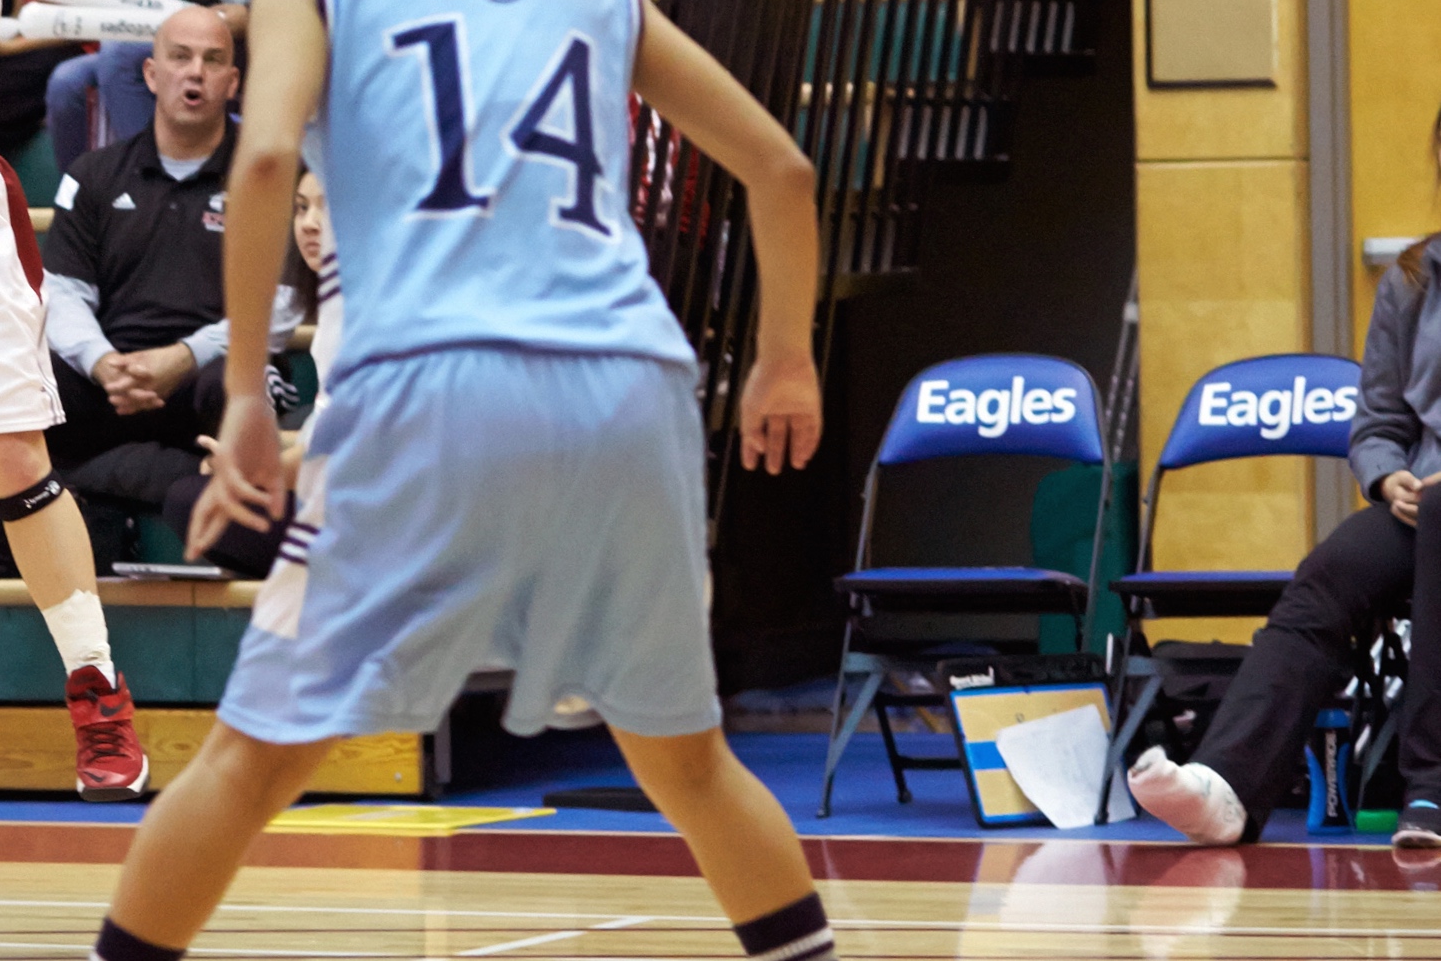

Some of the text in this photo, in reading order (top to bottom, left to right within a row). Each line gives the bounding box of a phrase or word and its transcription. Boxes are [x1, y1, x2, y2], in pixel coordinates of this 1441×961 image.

[382, 12, 622, 245] 14
[916, 376, 1077, 438] Eagles
[1198, 375, 1358, 440] Eagles
